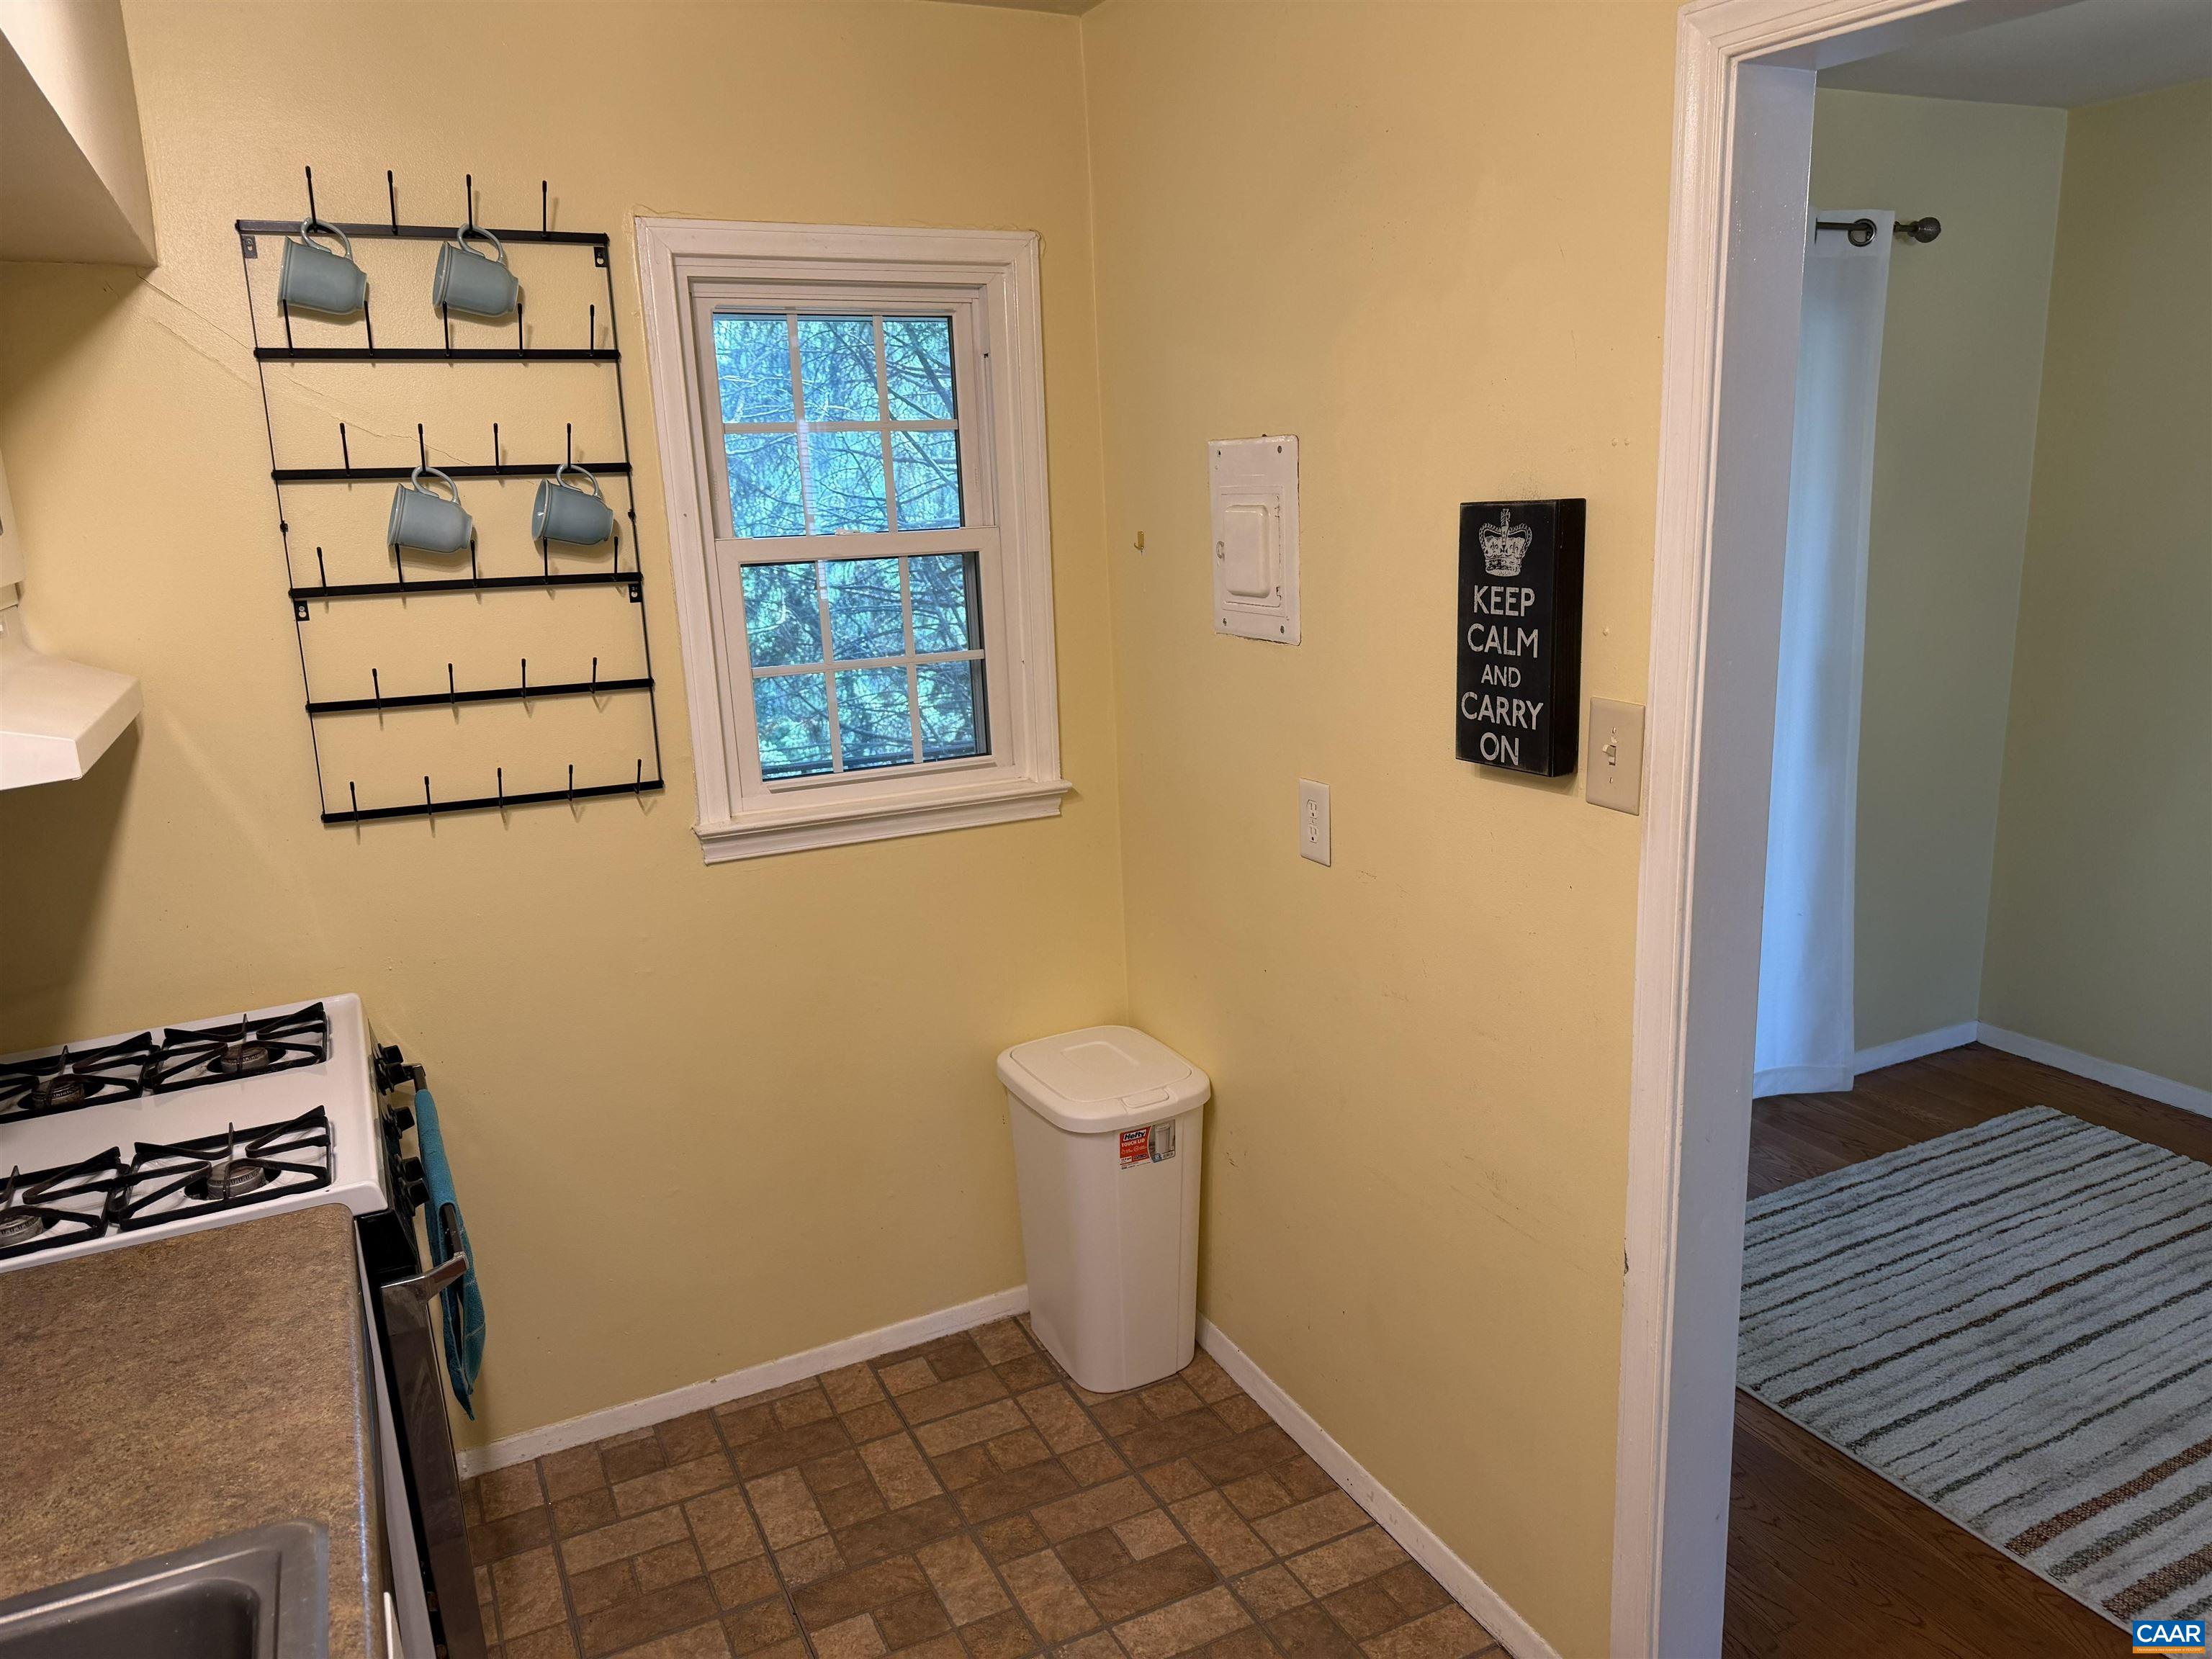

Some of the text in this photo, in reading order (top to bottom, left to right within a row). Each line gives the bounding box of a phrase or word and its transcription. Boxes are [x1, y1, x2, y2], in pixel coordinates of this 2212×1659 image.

[1474, 585, 1535, 616] KEEP
[1467, 623, 1539, 658] CALM
[1480, 664, 1521, 688] AND
[1461, 692, 1544, 730] CARRY
[1480, 732, 1519, 765] ON
[1124, 1131, 1146, 1141] Hefty
